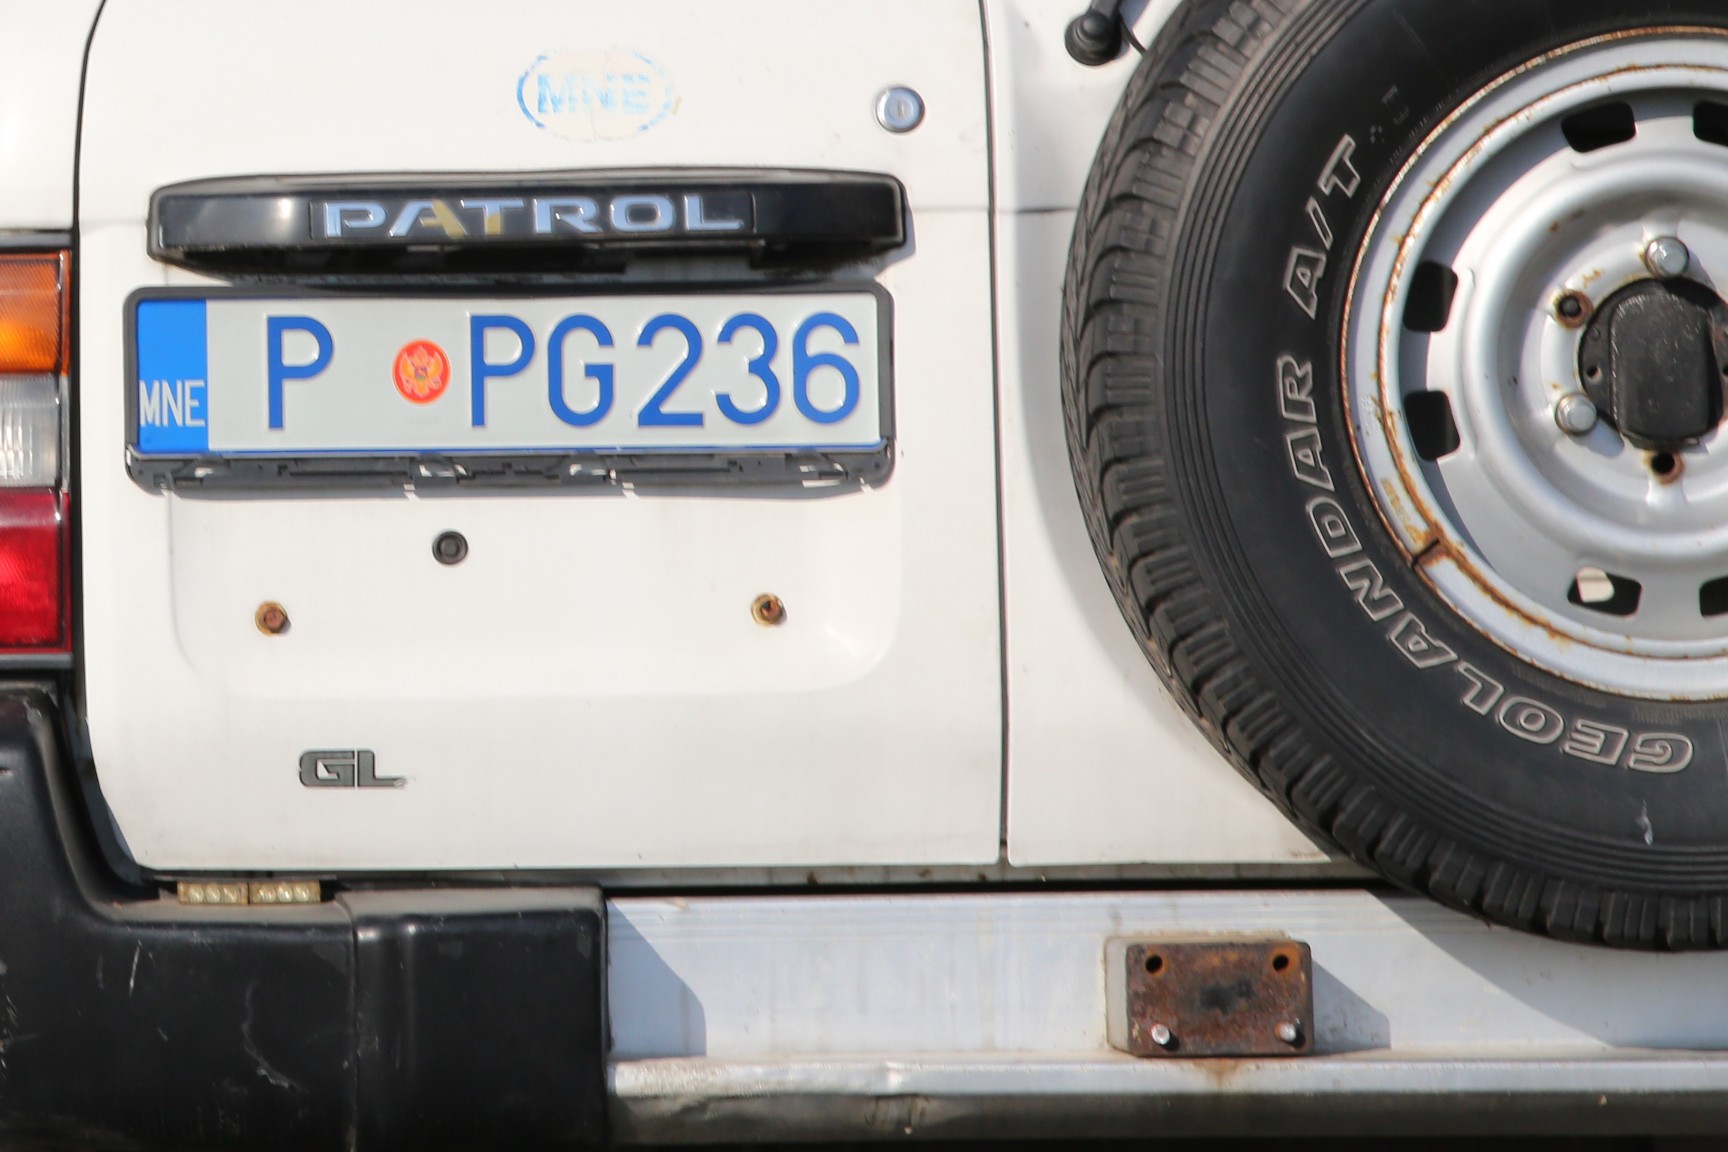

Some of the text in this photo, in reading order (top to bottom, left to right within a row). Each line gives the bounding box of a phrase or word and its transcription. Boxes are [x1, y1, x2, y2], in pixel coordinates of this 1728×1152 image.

[537, 72, 650, 114] MNE
[322, 194, 746, 238] PATROL
[139, 311, 861, 430] MNE P PG236
[1276, 353, 1694, 775] GEOLANDAR
[299, 749, 406, 788] GL
